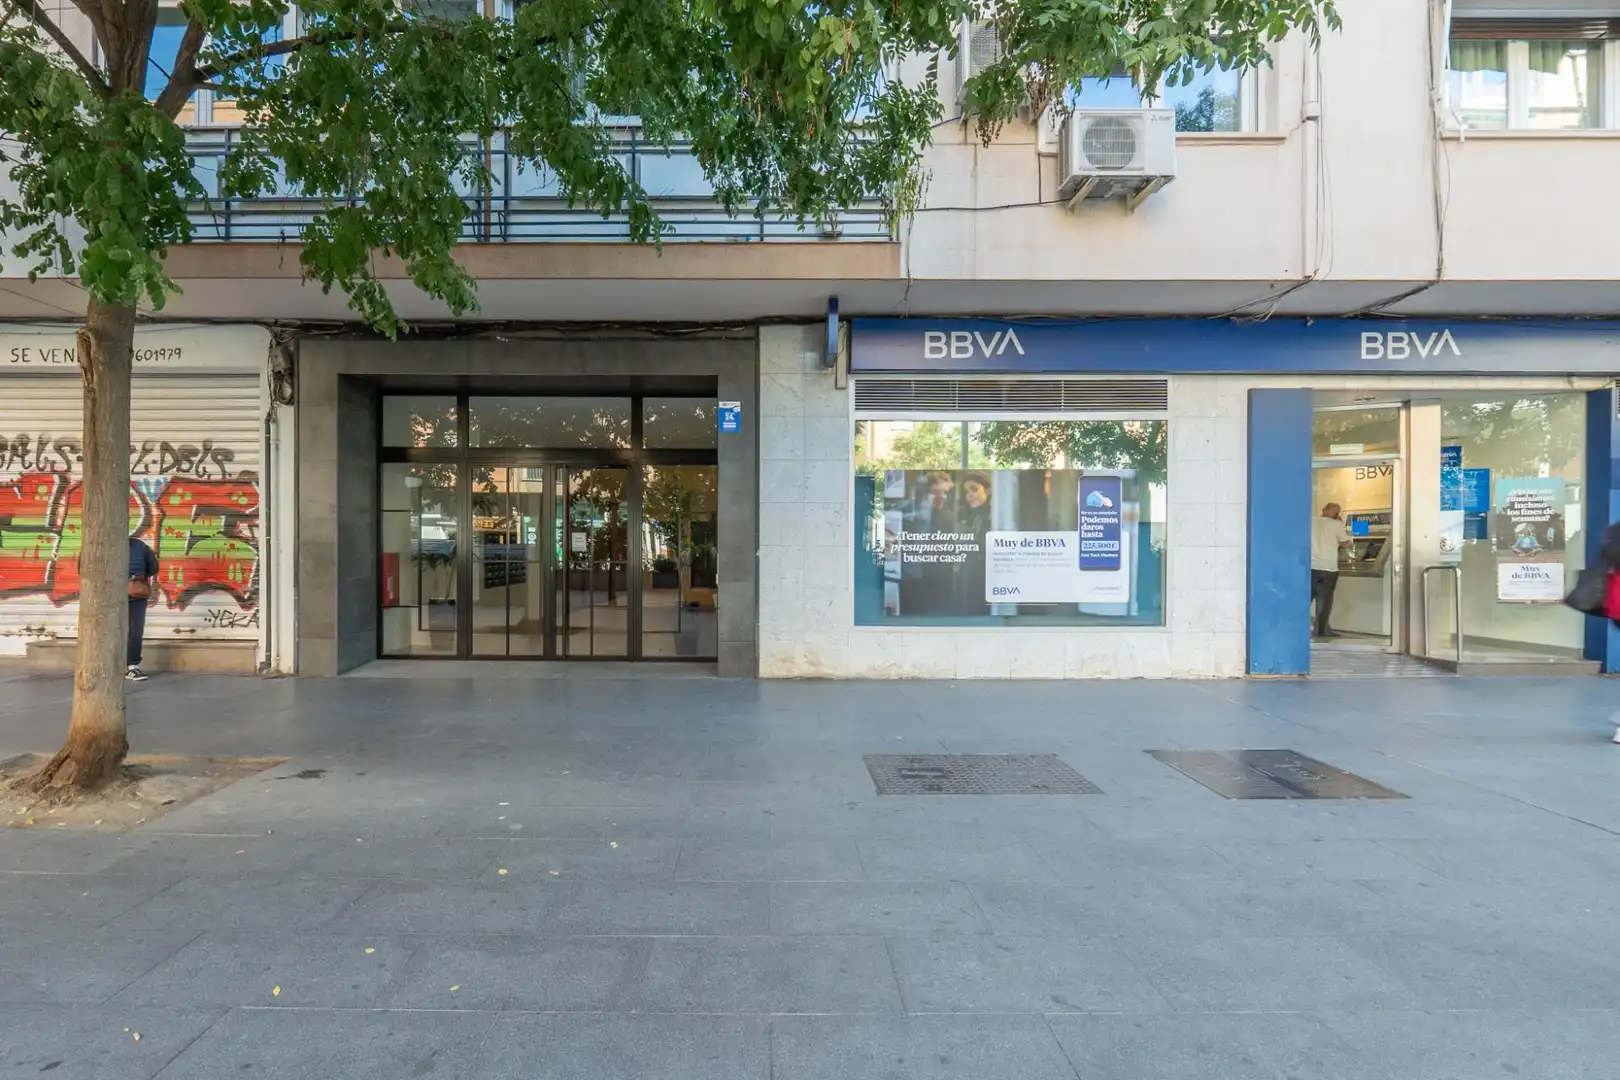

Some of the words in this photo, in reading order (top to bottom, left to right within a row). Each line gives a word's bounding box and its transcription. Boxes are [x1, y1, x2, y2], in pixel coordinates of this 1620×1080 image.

[924, 328, 1025, 359] BBVA
[1360, 328, 1461, 360] BBVA
[10, 348, 31, 363] SE
[39, 348, 81, 363] VEN
[1507, 508, 1520, 516] los
[895, 530, 931, 541] ¿Tener
[931, 530, 958, 541] claro
[958, 532, 975, 541] un
[1081, 530, 1103, 538] hasta
[890, 542, 954, 554] presupuesto
[955, 544, 980, 554] para
[993, 538, 1018, 549] Muy
[1020, 537, 1034, 548] de
[1035, 538, 1066, 548] BBVA
[903, 553, 938, 563] buscar
[939, 553, 967, 563] casa?
[992, 586, 1021, 595] BBVA
